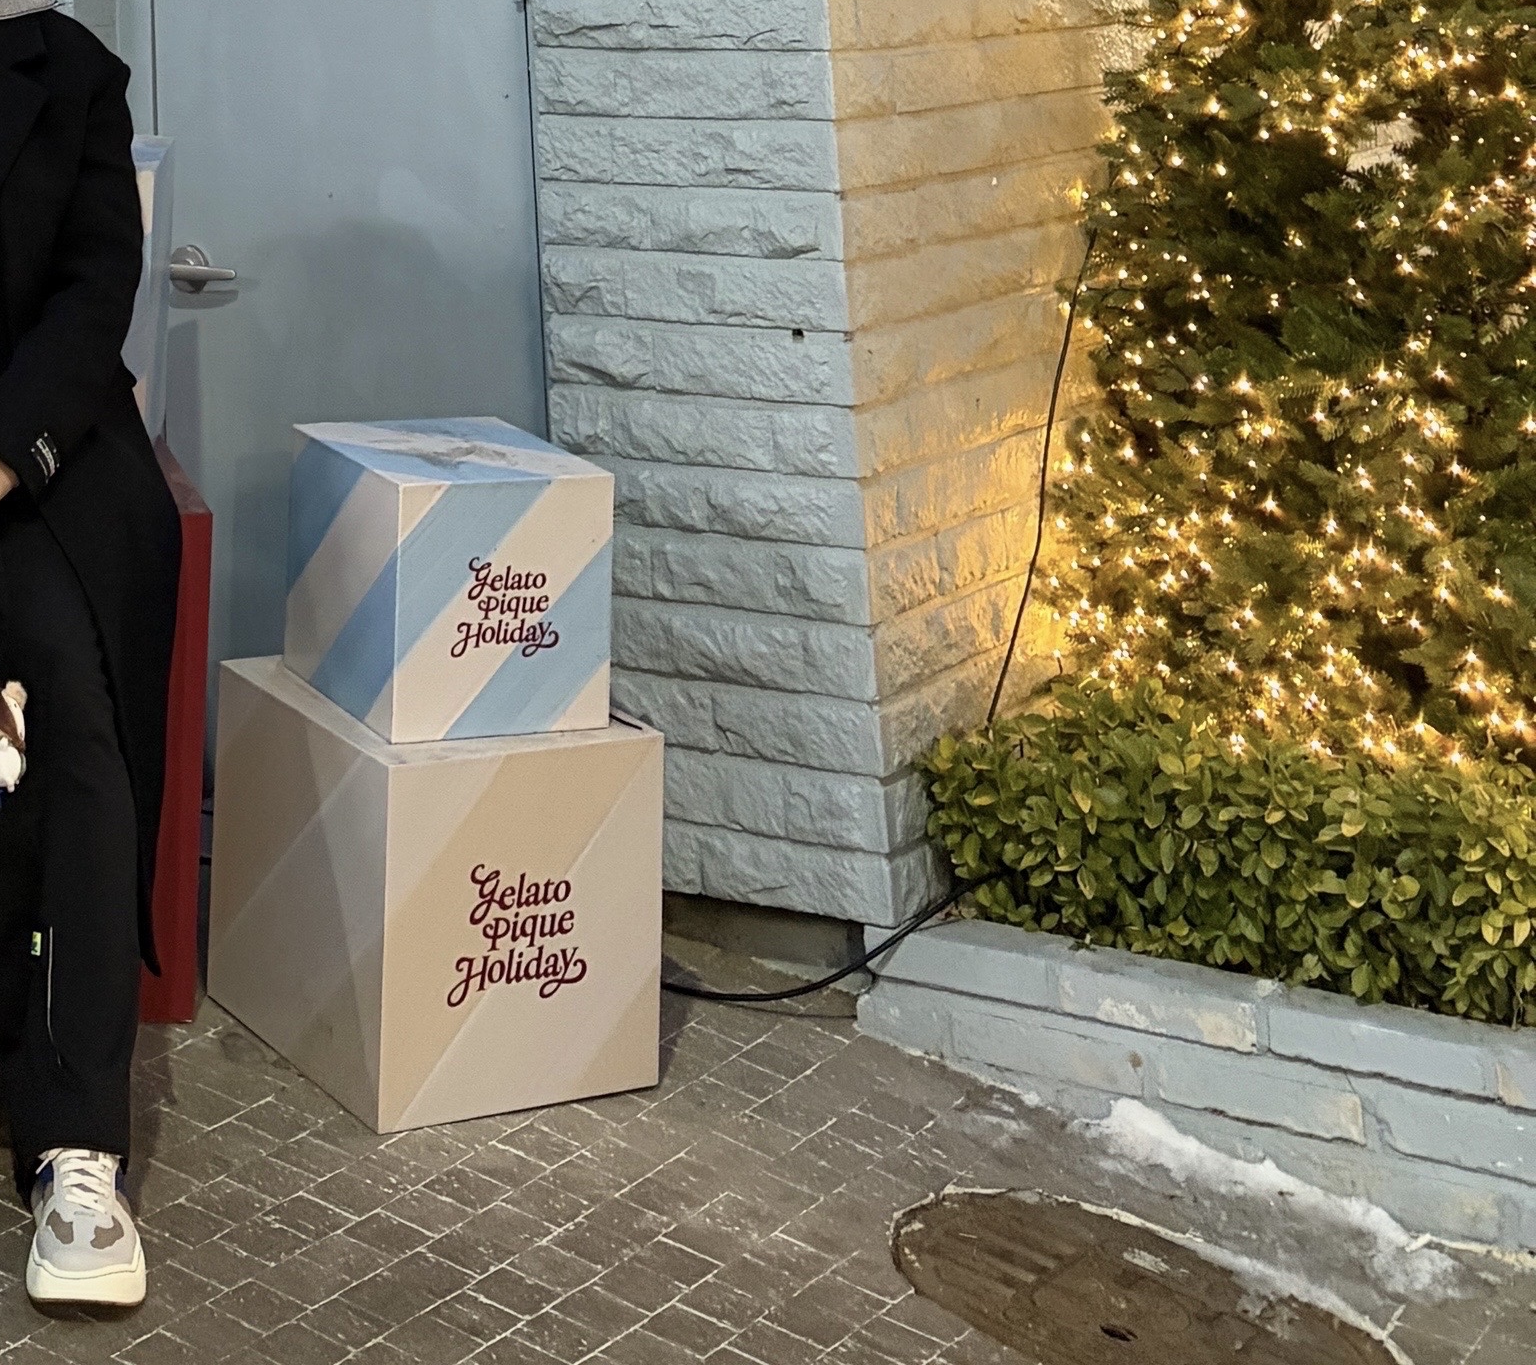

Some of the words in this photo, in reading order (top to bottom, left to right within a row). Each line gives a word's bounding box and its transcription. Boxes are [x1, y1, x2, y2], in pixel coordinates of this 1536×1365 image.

[468, 556, 547, 600] Gelato
[478, 592, 549, 620] Pique
[451, 619, 559, 658] Holiday
[469, 863, 571, 925] Gelato
[482, 909, 574, 951] Pique
[446, 945, 587, 1007] Holiday
